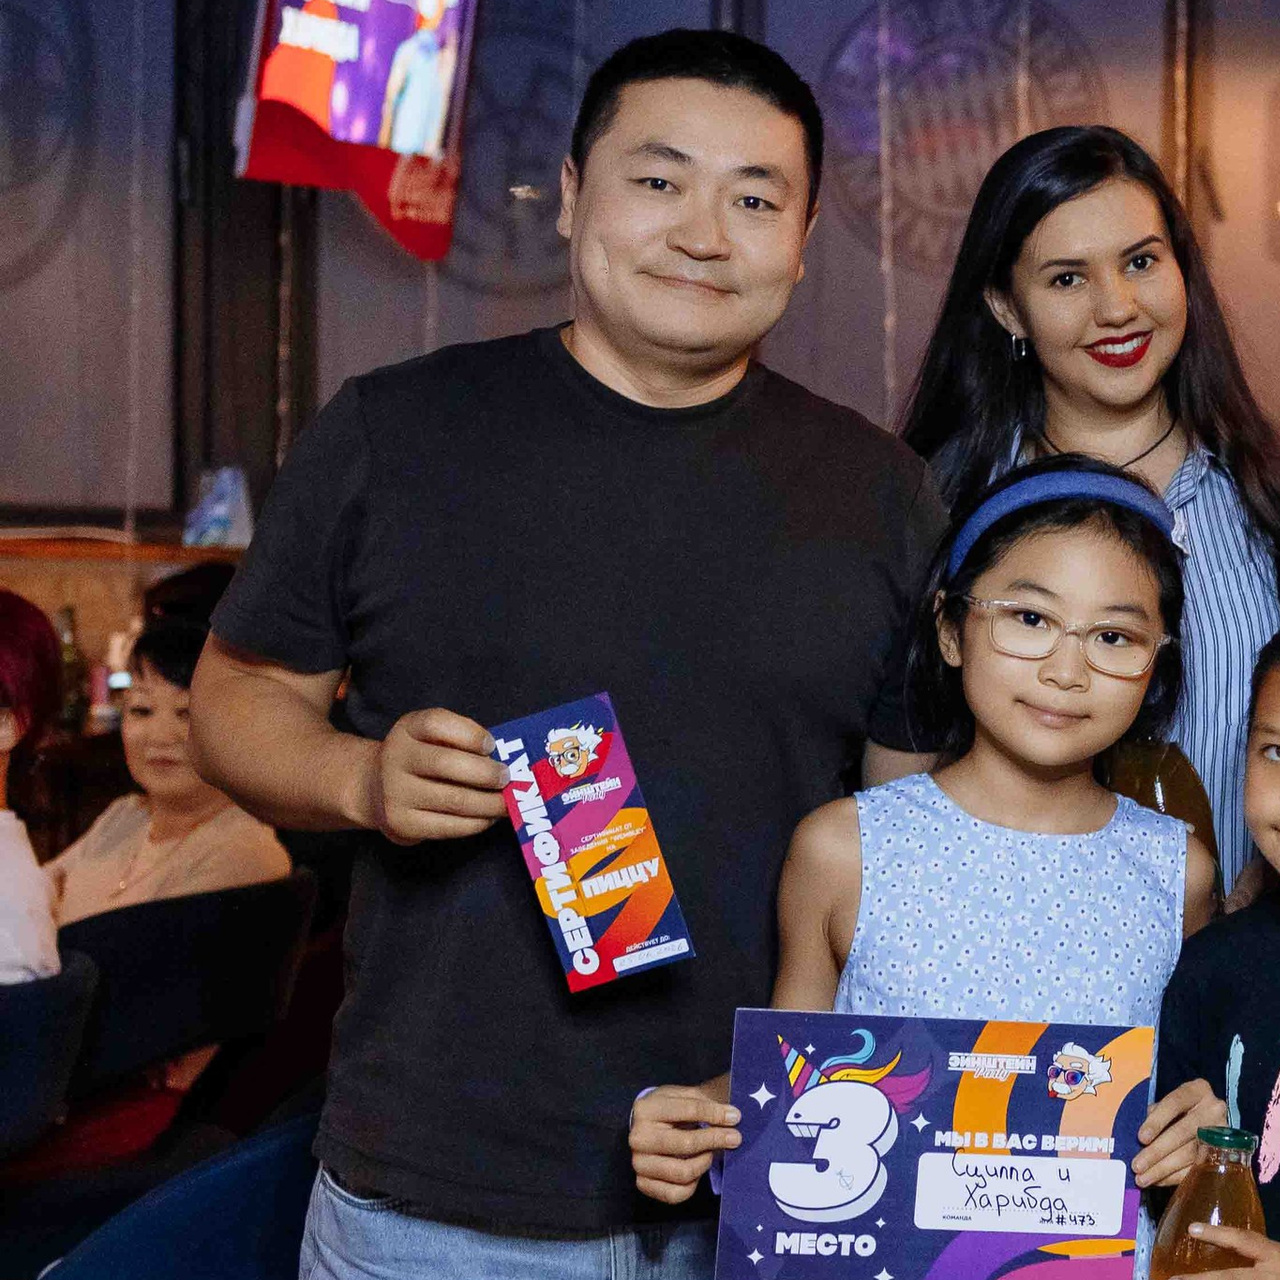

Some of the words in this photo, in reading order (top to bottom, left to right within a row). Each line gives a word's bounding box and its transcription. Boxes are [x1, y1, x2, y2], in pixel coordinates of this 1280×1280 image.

[497, 737, 601, 976] СЕРТИФИКАТ
[581, 857, 660, 899] ПИЦЦУ
[934, 1130, 971, 1148] МЫ
[975, 1132, 988, 1148] В
[992, 1133, 1037, 1151] ВАС
[1041, 1134, 1115, 1153] ВЕРИМ!
[1058, 1167, 1071, 1182] и
[964, 1183, 1068, 1221] Харибда
[942, 1214, 972, 1222] КОМАНДА
[775, 1231, 877, 1258] МЕСТО
